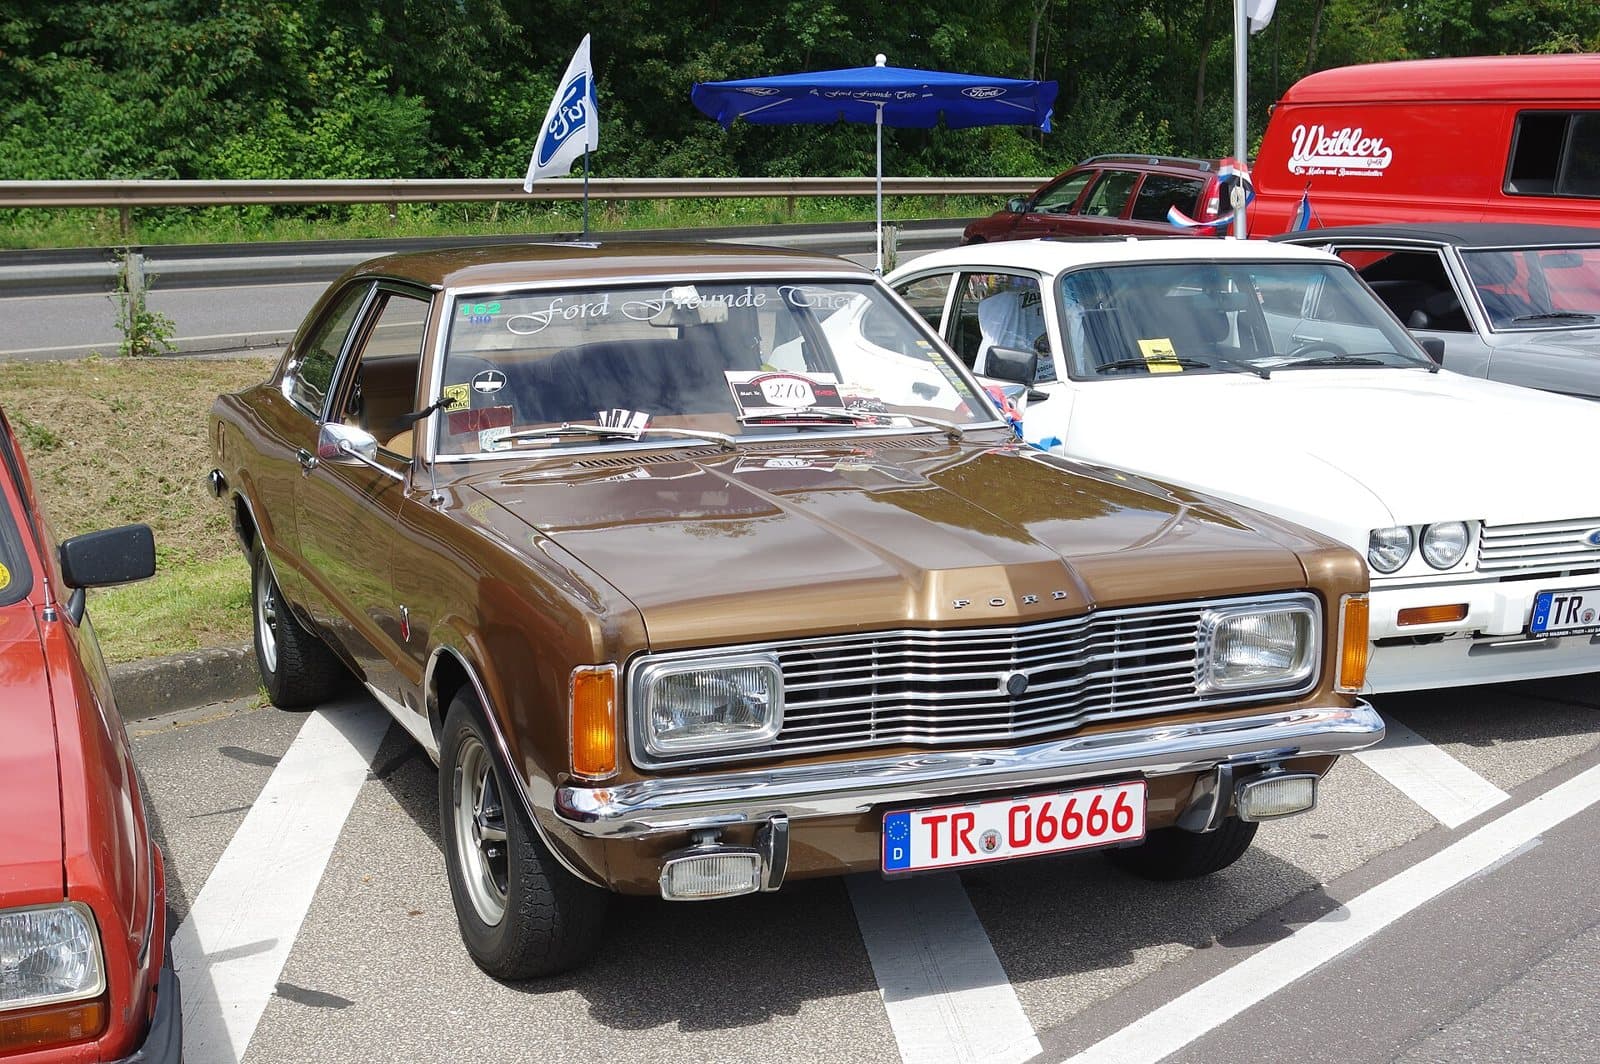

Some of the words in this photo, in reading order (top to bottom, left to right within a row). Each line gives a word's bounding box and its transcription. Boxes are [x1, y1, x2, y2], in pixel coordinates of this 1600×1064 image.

[853, 90, 893, 98] Freunde
[895, 91, 918, 99] Trier
[969, 87, 999, 98] Ford
[1291, 124, 1390, 161] Weibler
[460, 302, 502, 316] 162
[507, 293, 610, 335] Ford
[621, 286, 767, 320] Freunde
[953, 590, 1067, 609] FORD
[1553, 595, 1584, 625] TR
[1537, 615, 1544, 625] D
[922, 811, 977, 859] TR
[1008, 791, 1134, 849] 06666
[893, 847, 903, 860] D
